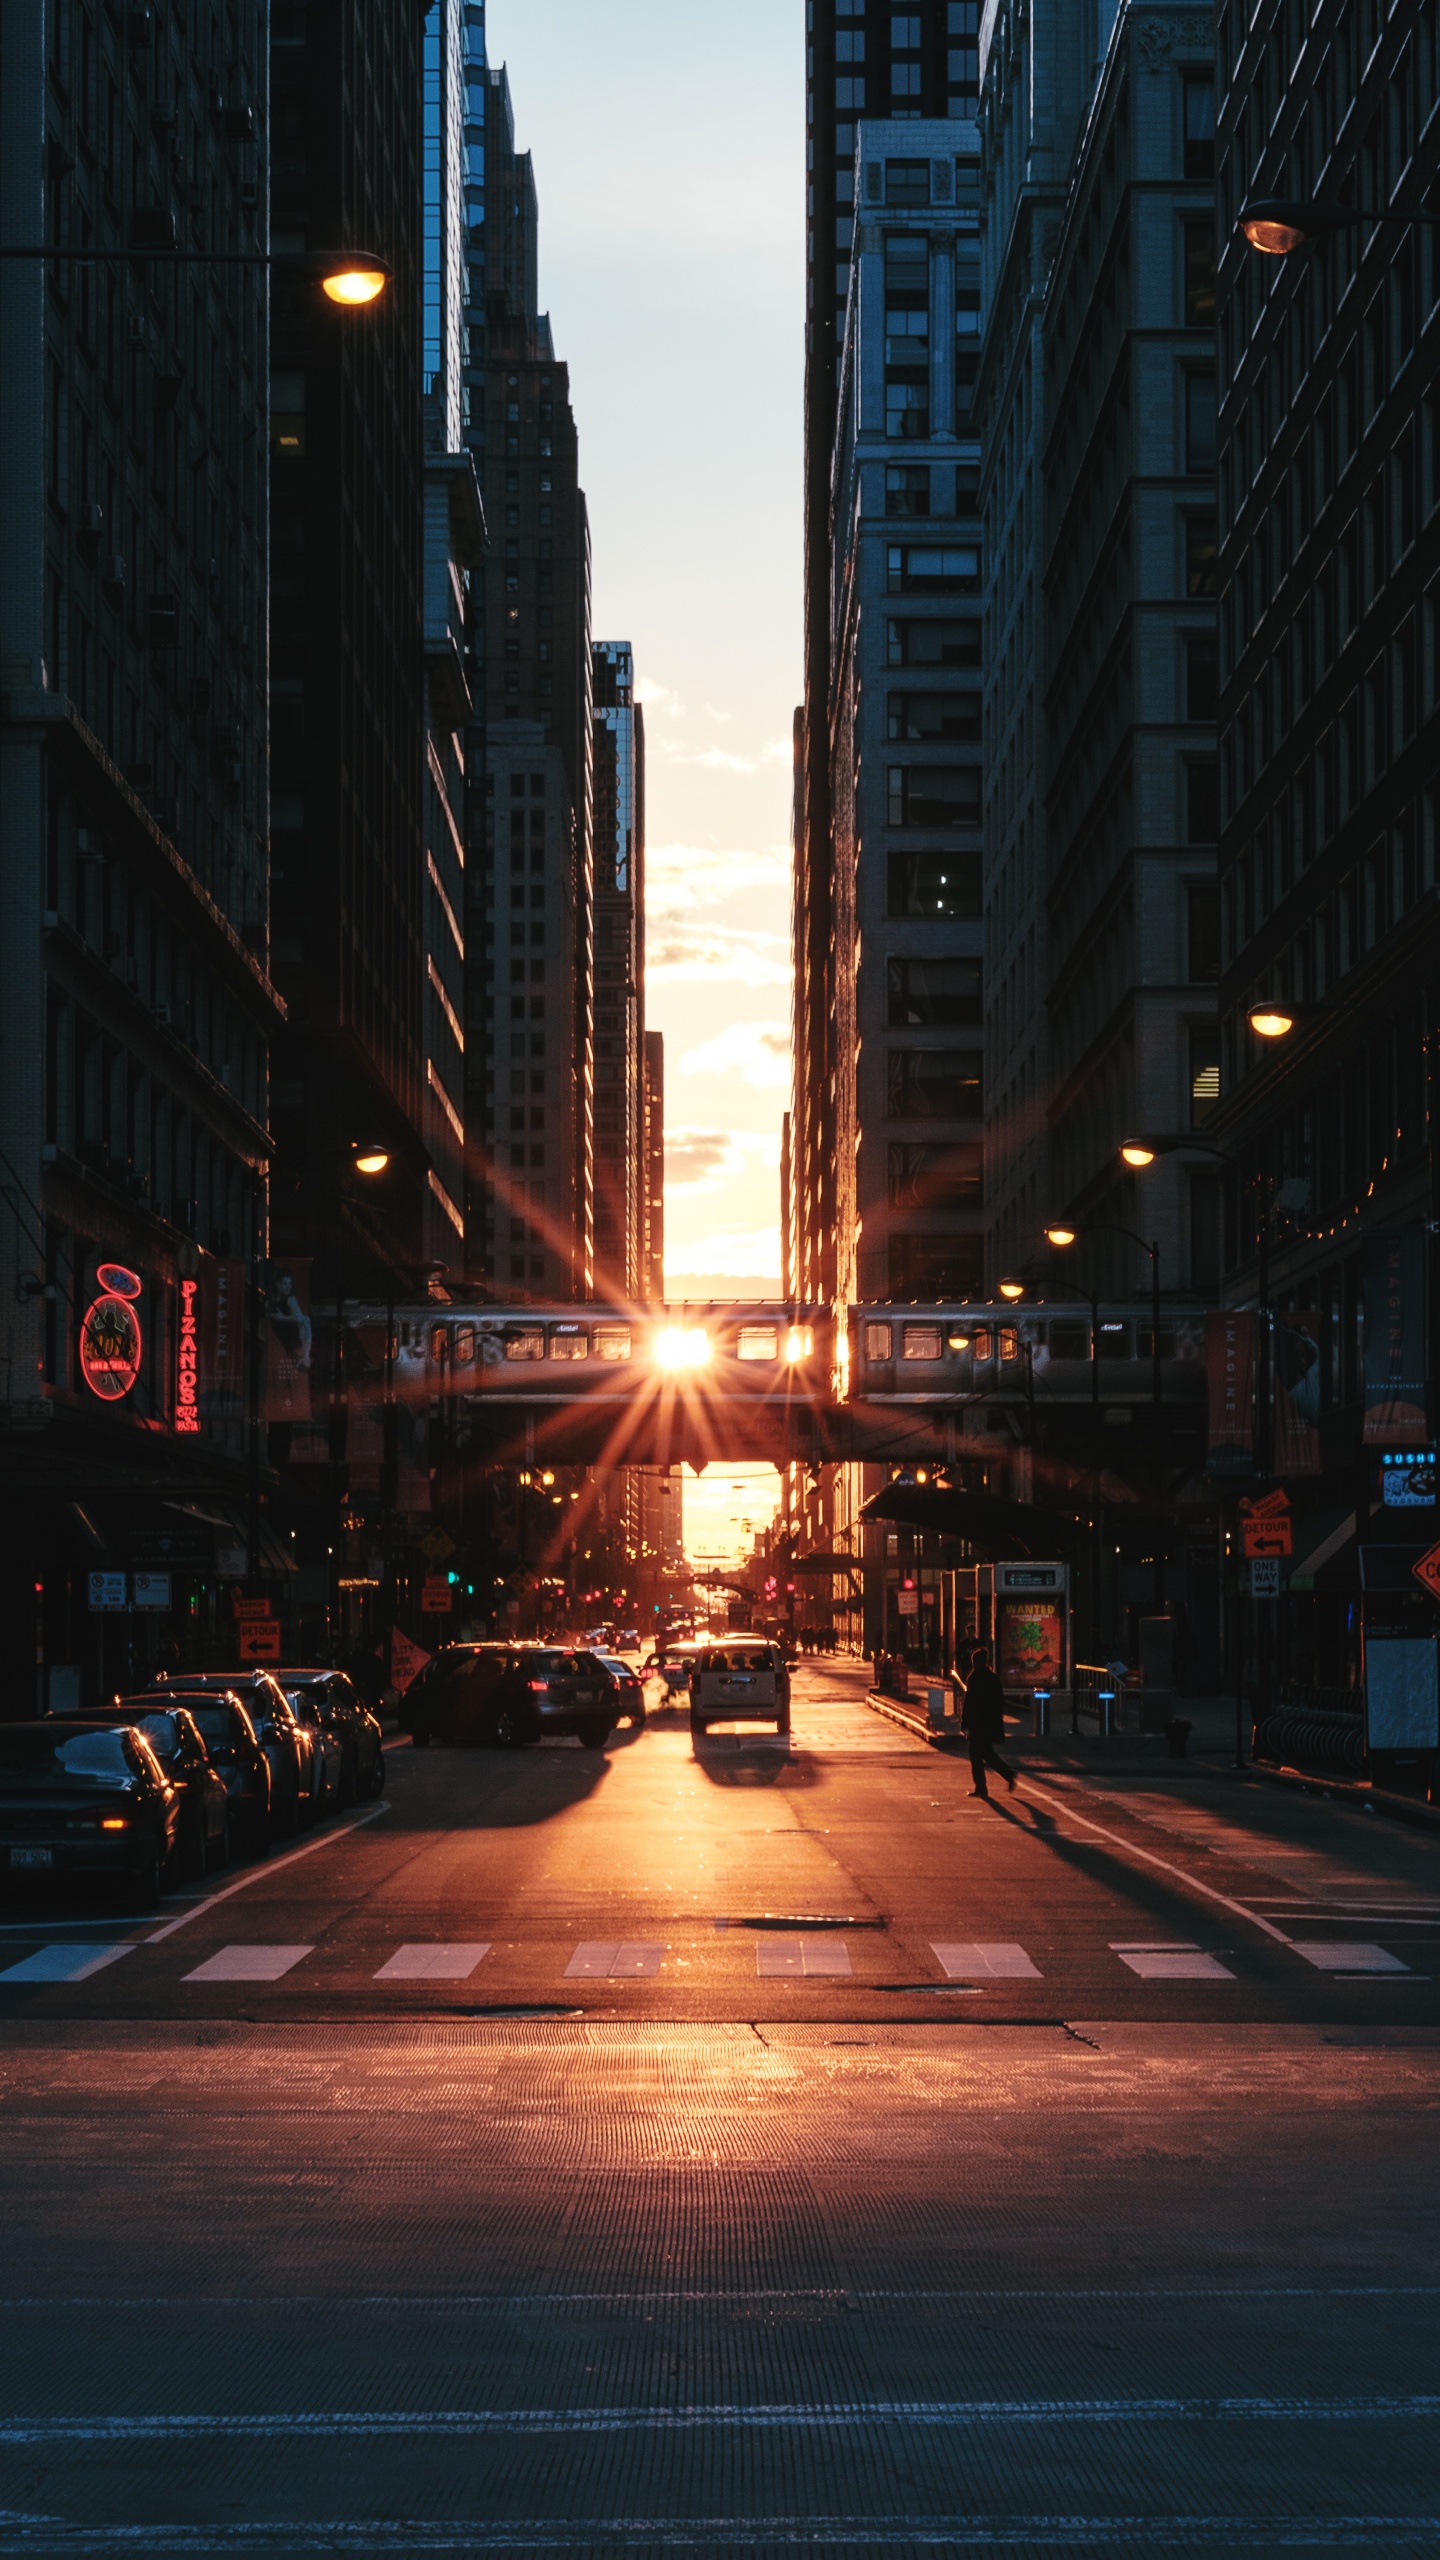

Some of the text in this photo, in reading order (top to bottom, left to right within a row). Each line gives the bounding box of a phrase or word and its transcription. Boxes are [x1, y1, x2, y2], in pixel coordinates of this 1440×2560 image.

[1387, 1238, 1401, 1358] IMAGINE
[218, 1267, 228, 1357] IMAGINE
[1225, 1320, 1236, 1410] IMAGINE
[1383, 1453, 1435, 1465] SUSHI
[1245, 1521, 1288, 1534] DETOUR
[1254, 1562, 1276, 1571] ONE
[1255, 1572, 1277, 1582] WAY
[1006, 1604, 1055, 1614] WANTED
[241, 1626, 279, 1636] DETOUR
